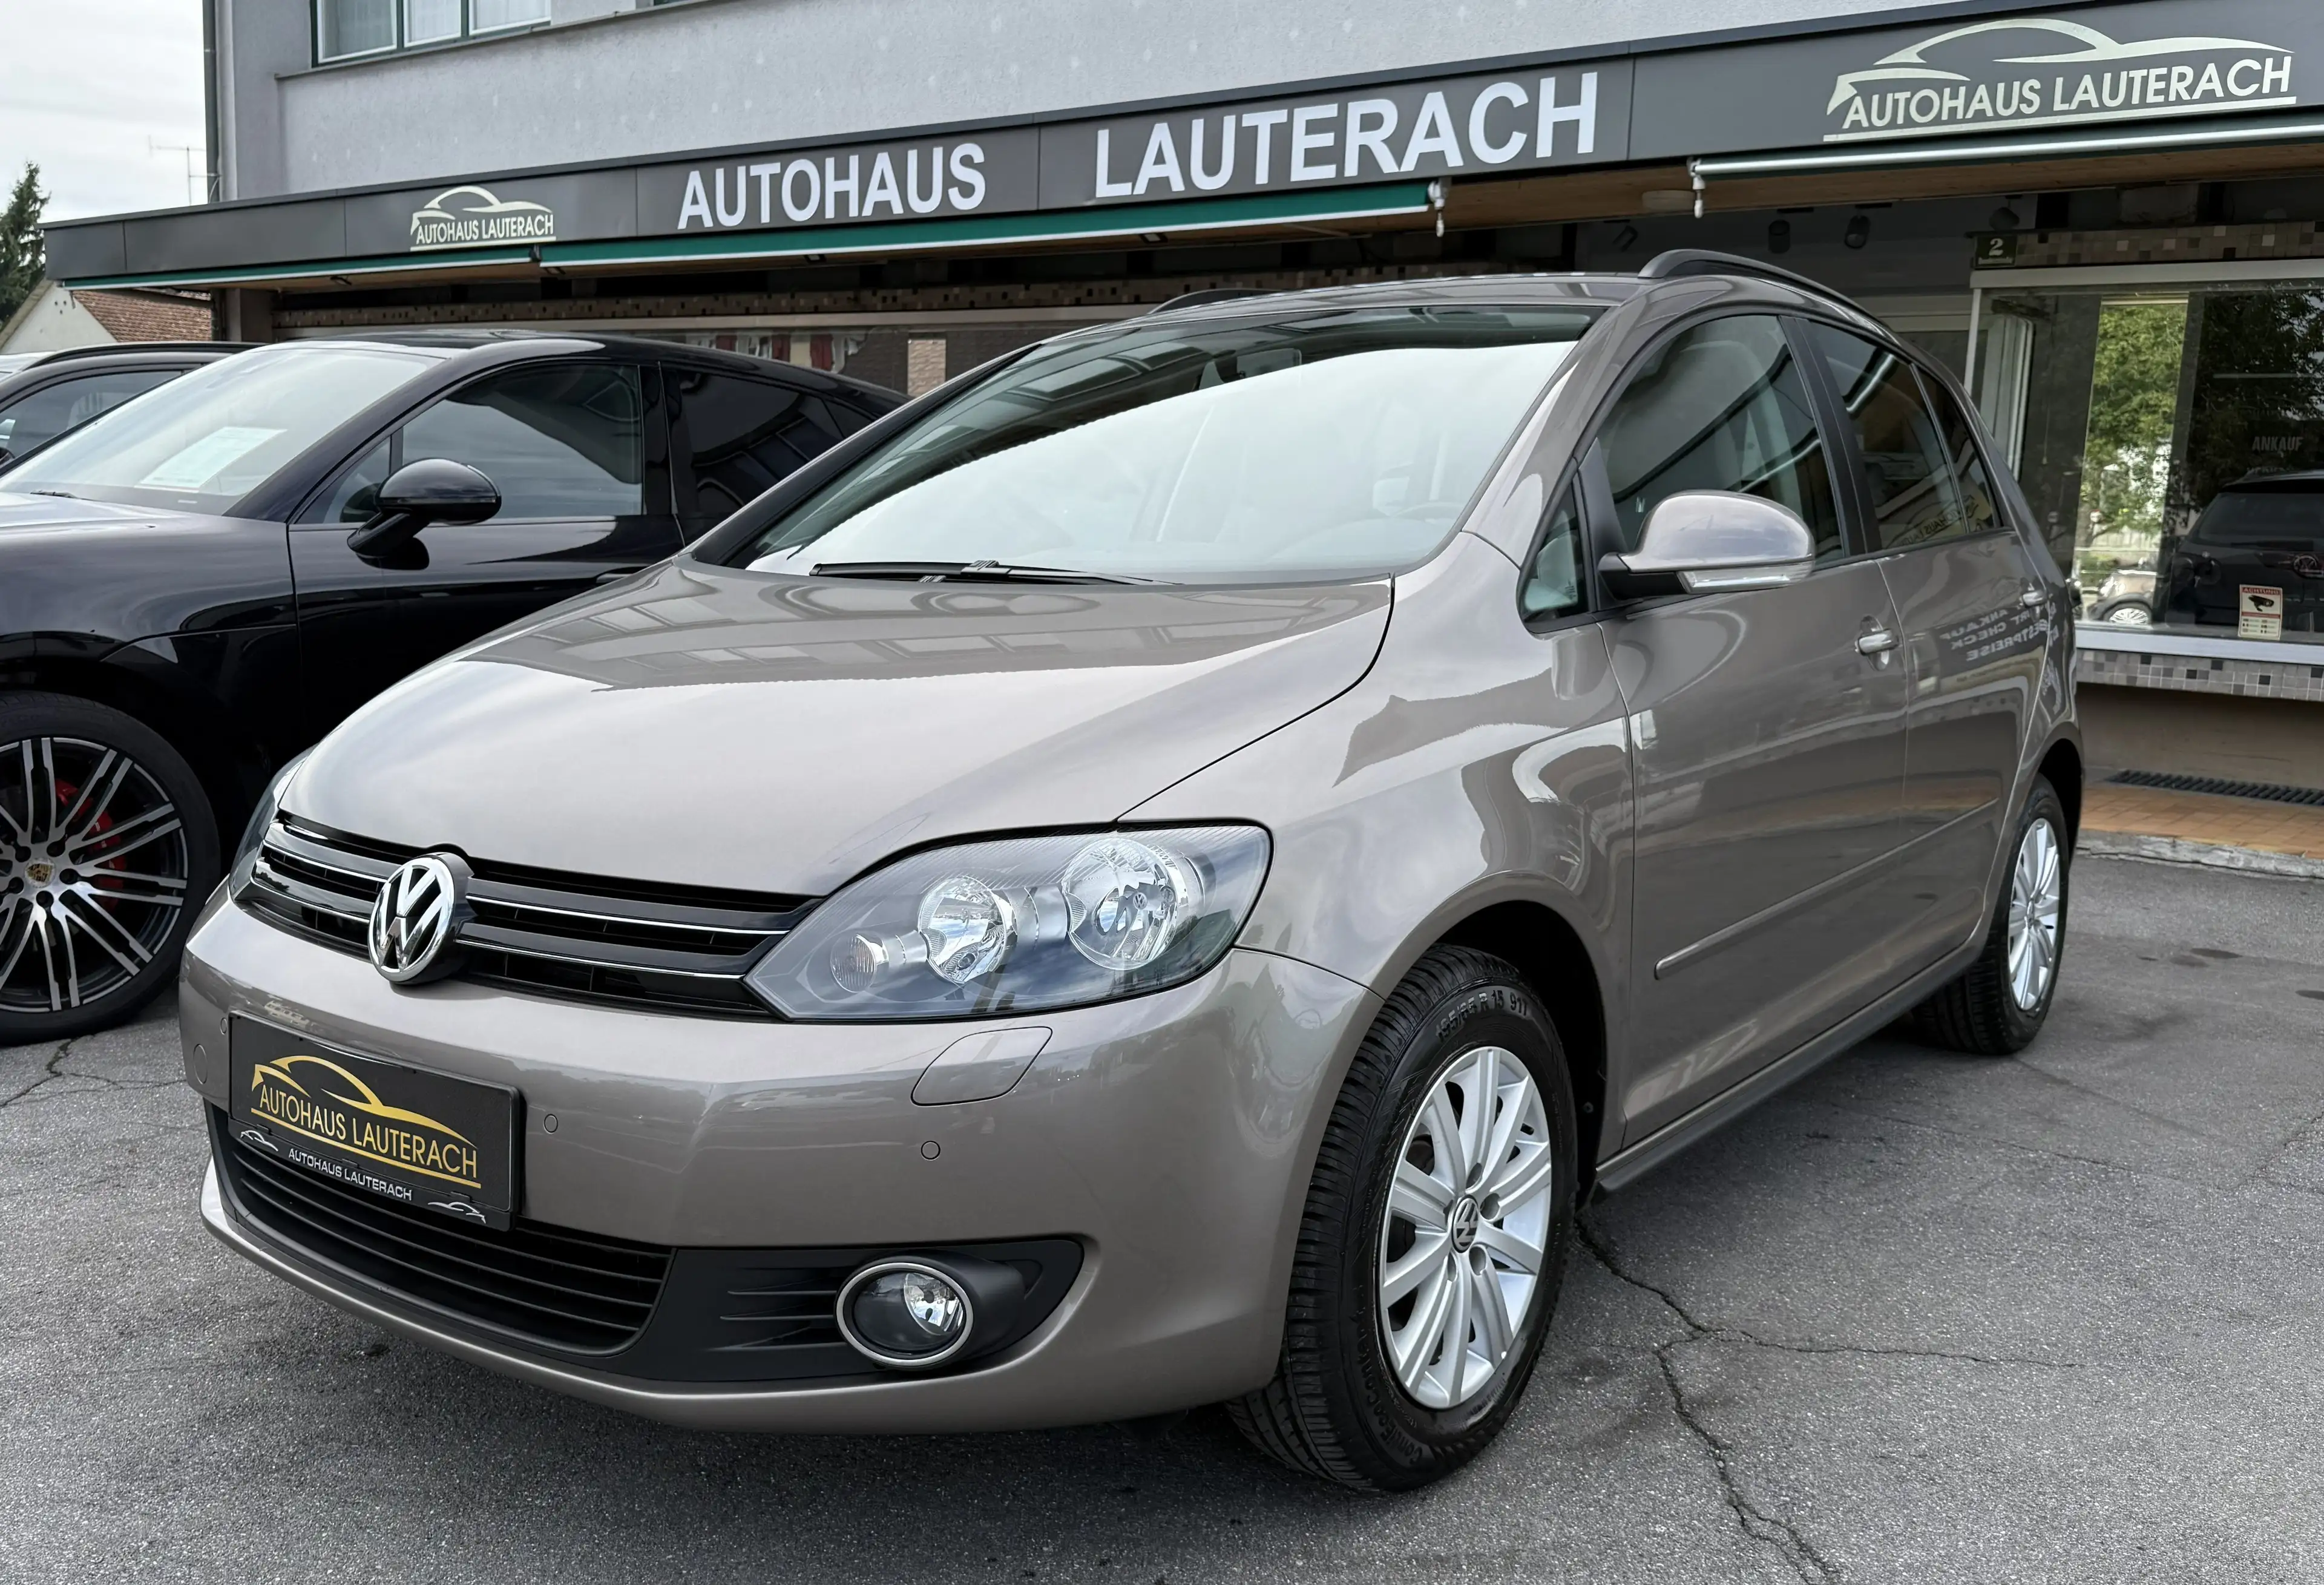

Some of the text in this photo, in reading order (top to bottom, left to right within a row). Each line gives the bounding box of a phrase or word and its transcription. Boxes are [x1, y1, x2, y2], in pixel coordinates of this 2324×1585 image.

[1843, 56, 2293, 129] AUTOHAUS LAUTERACH
[677, 71, 1598, 230] AUTOHAUS LAUTERACH
[416, 214, 554, 244] AUTOHAUS LAUTERACH
[1988, 237, 2004, 257] 2
[2252, 436, 2305, 452] ANKAUF
[370, 855, 453, 979] VW
[1479, 993, 1490, 1012] R
[1491, 989, 1505, 1010] 15
[260, 1083, 477, 1179] AUTOHAUS LAUTERACH
[288, 1148, 412, 1201] AUTOHAUS LAUTERACH
